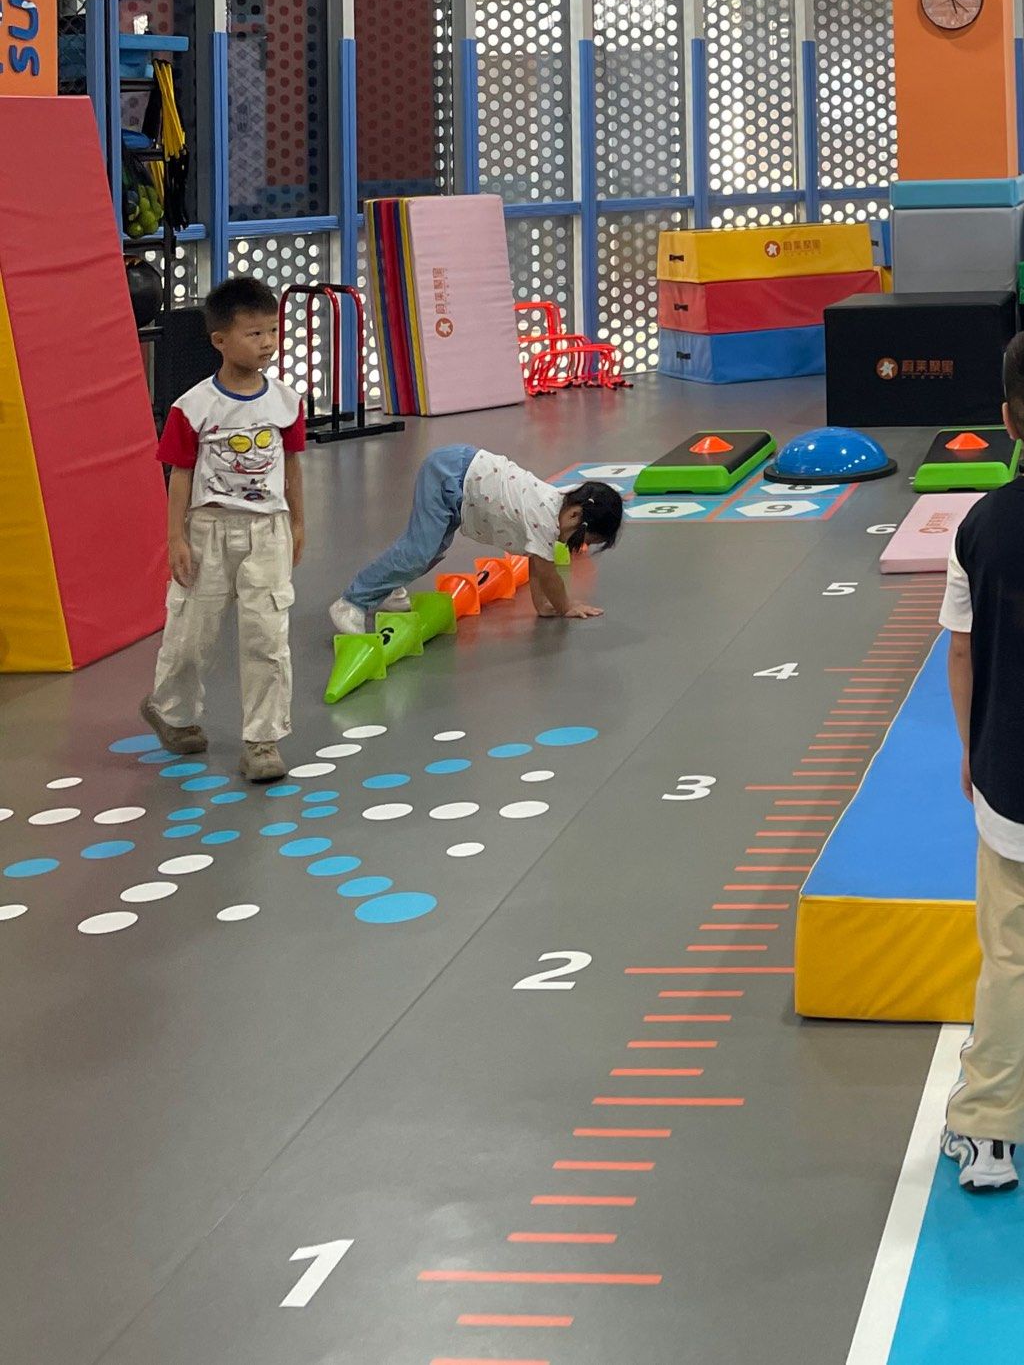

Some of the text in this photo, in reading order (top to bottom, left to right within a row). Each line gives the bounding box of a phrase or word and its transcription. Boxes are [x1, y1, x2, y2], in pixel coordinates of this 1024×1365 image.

[648, 505, 680, 514] 8
[866, 523, 898, 534] 6
[822, 582, 858, 595] 5
[753, 662, 799, 679] 4
[661, 775, 717, 800] 3
[512, 950, 592, 989] 2
[279, 1239, 354, 1307] 1
